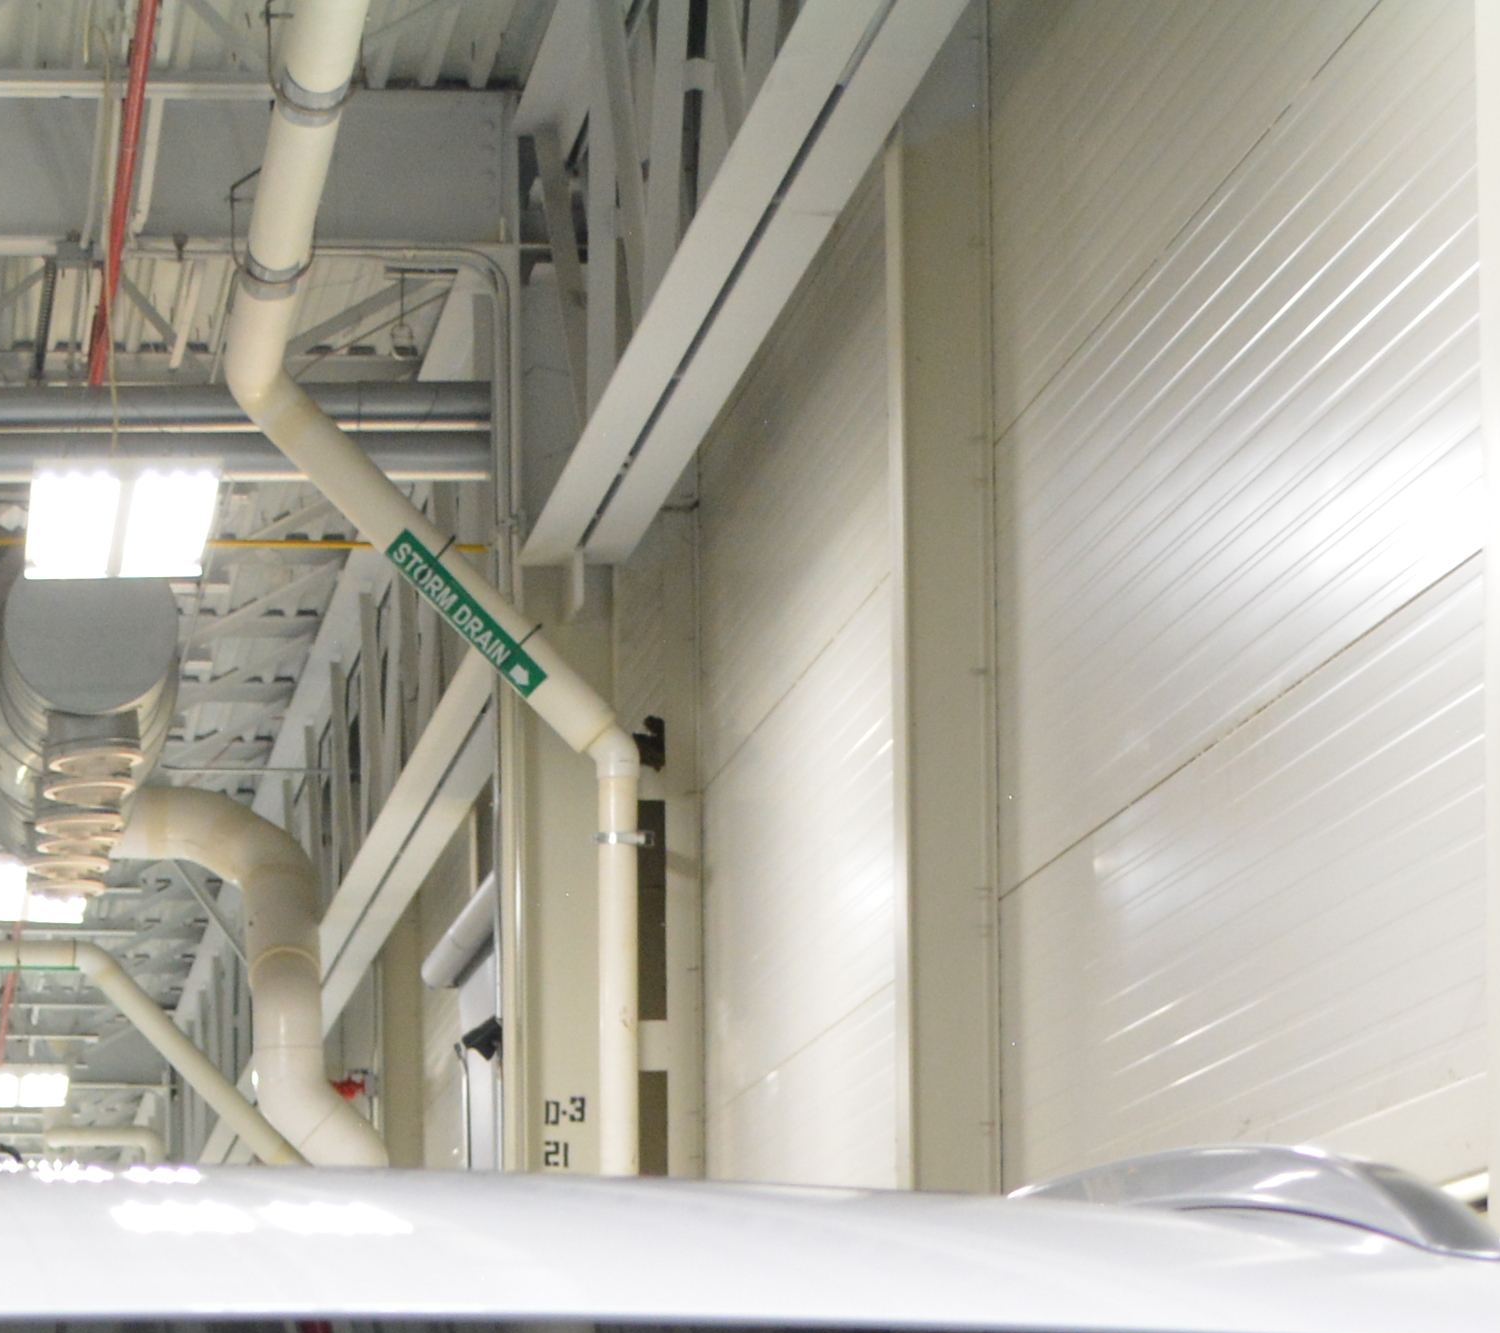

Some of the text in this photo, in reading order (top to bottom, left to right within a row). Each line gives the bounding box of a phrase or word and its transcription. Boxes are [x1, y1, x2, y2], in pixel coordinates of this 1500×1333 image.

[392, 541, 512, 666] STORM DRAIN
[544, 1140, 569, 1168] 21
